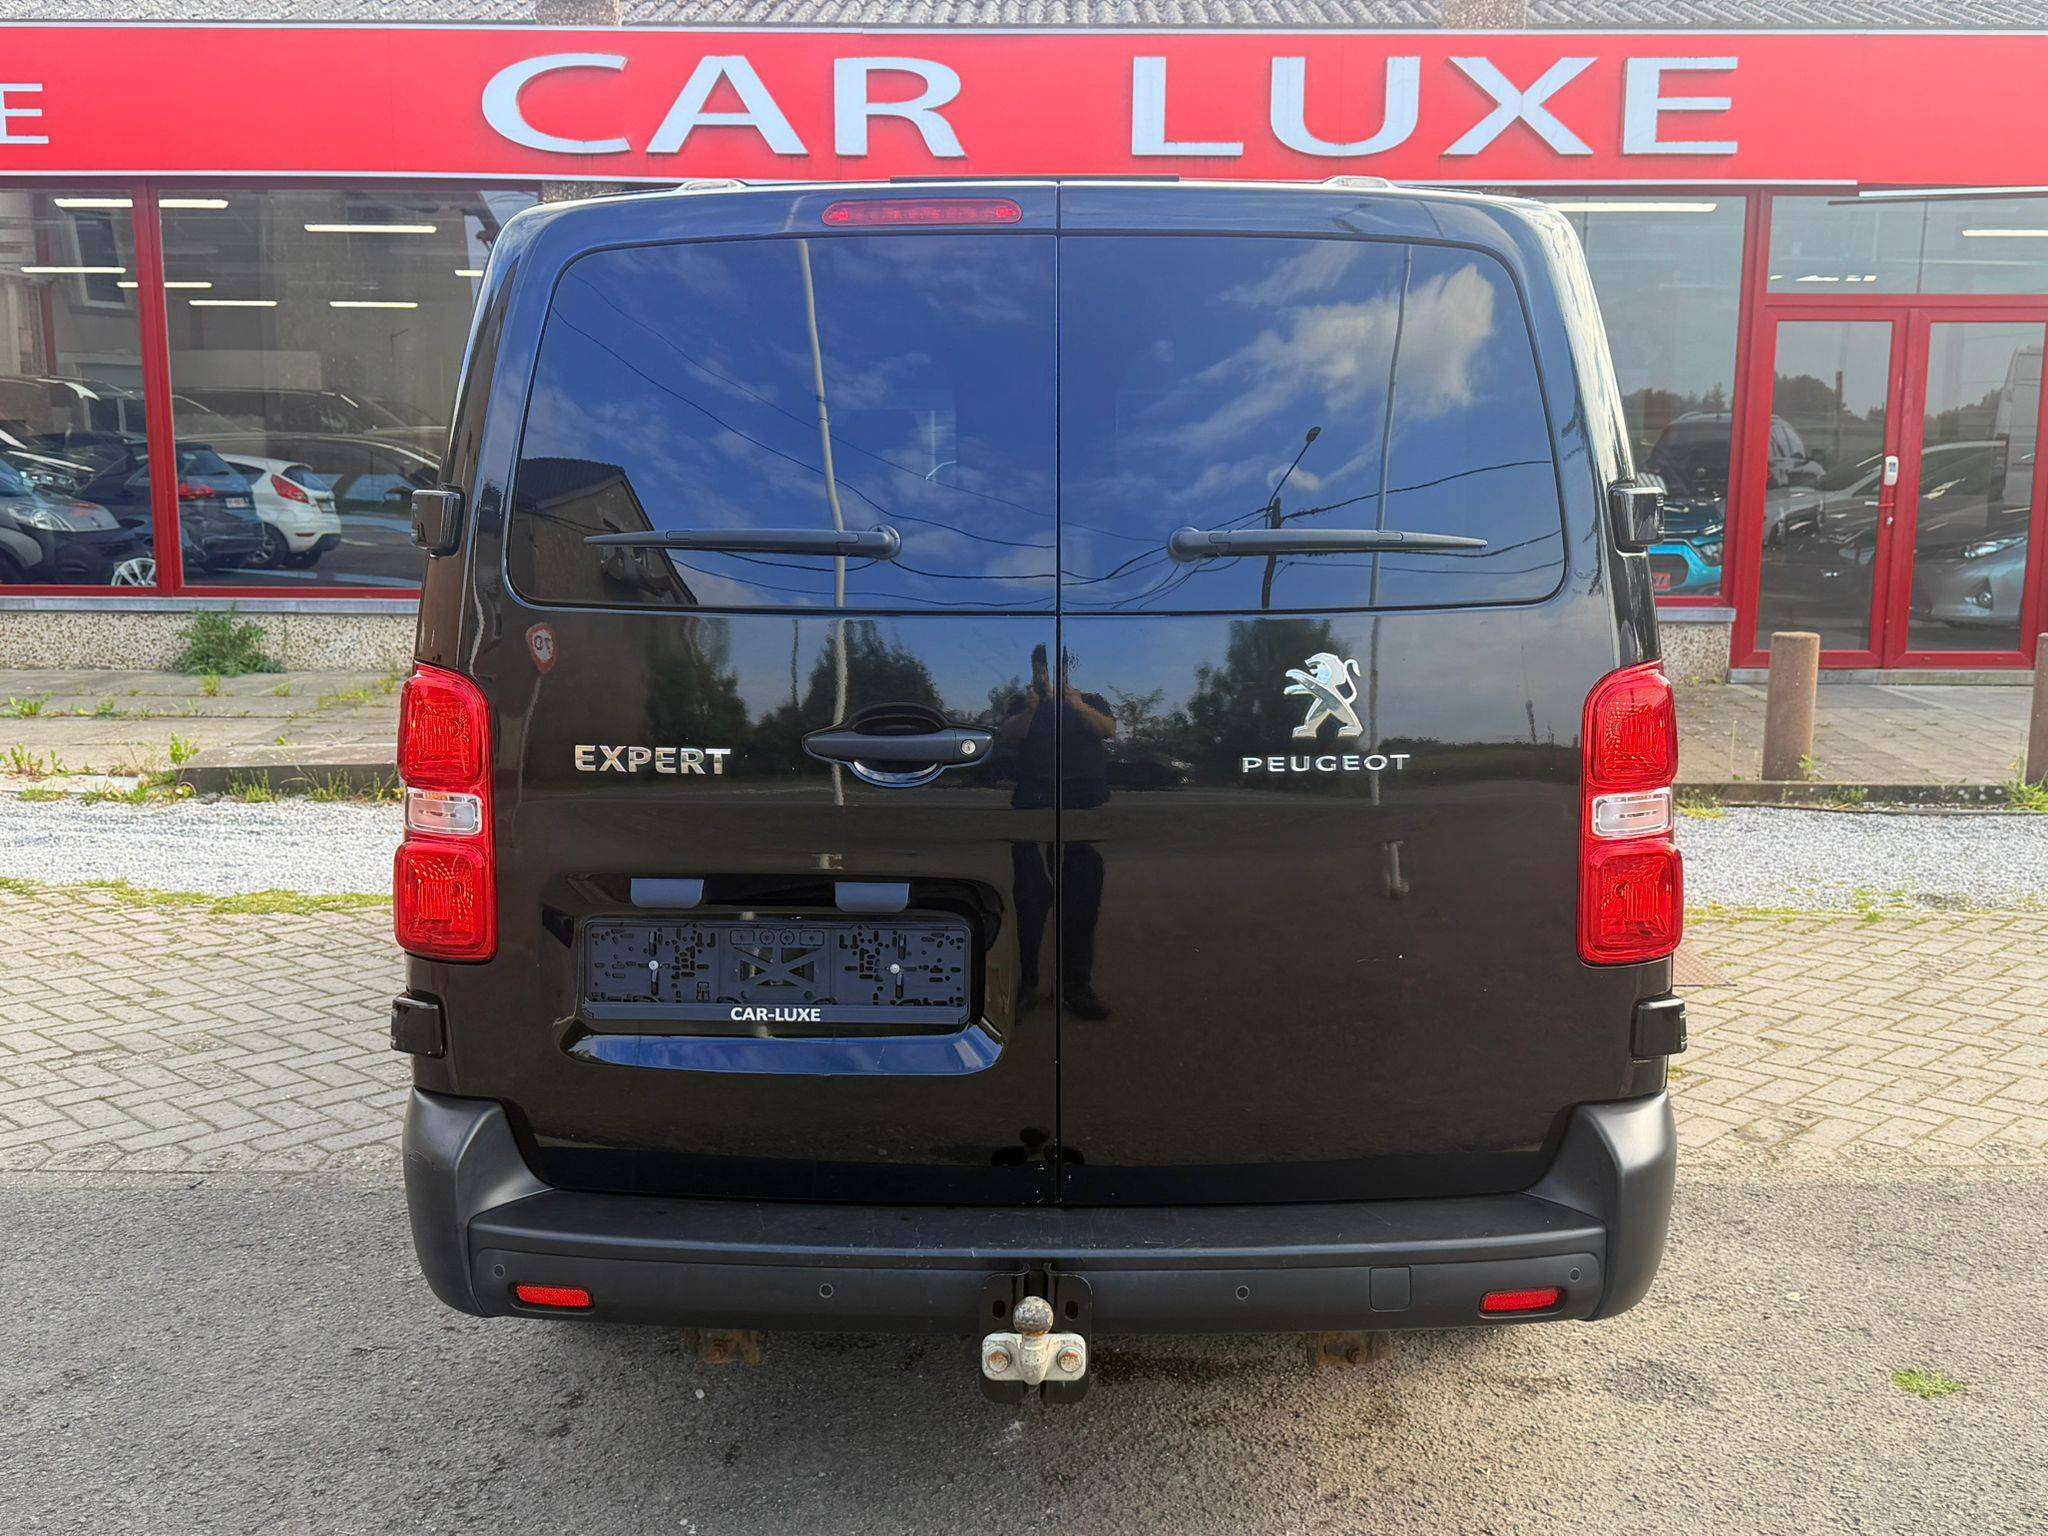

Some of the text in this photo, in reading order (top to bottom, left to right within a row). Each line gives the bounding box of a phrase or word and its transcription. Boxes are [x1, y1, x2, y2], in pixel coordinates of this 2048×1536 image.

[481, 53, 1739, 158] CAR LUXE
[575, 744, 731, 774] EXPERT
[1242, 754, 1410, 773] PEUGEOT
[730, 1007, 821, 1022] CAR-LUXE
